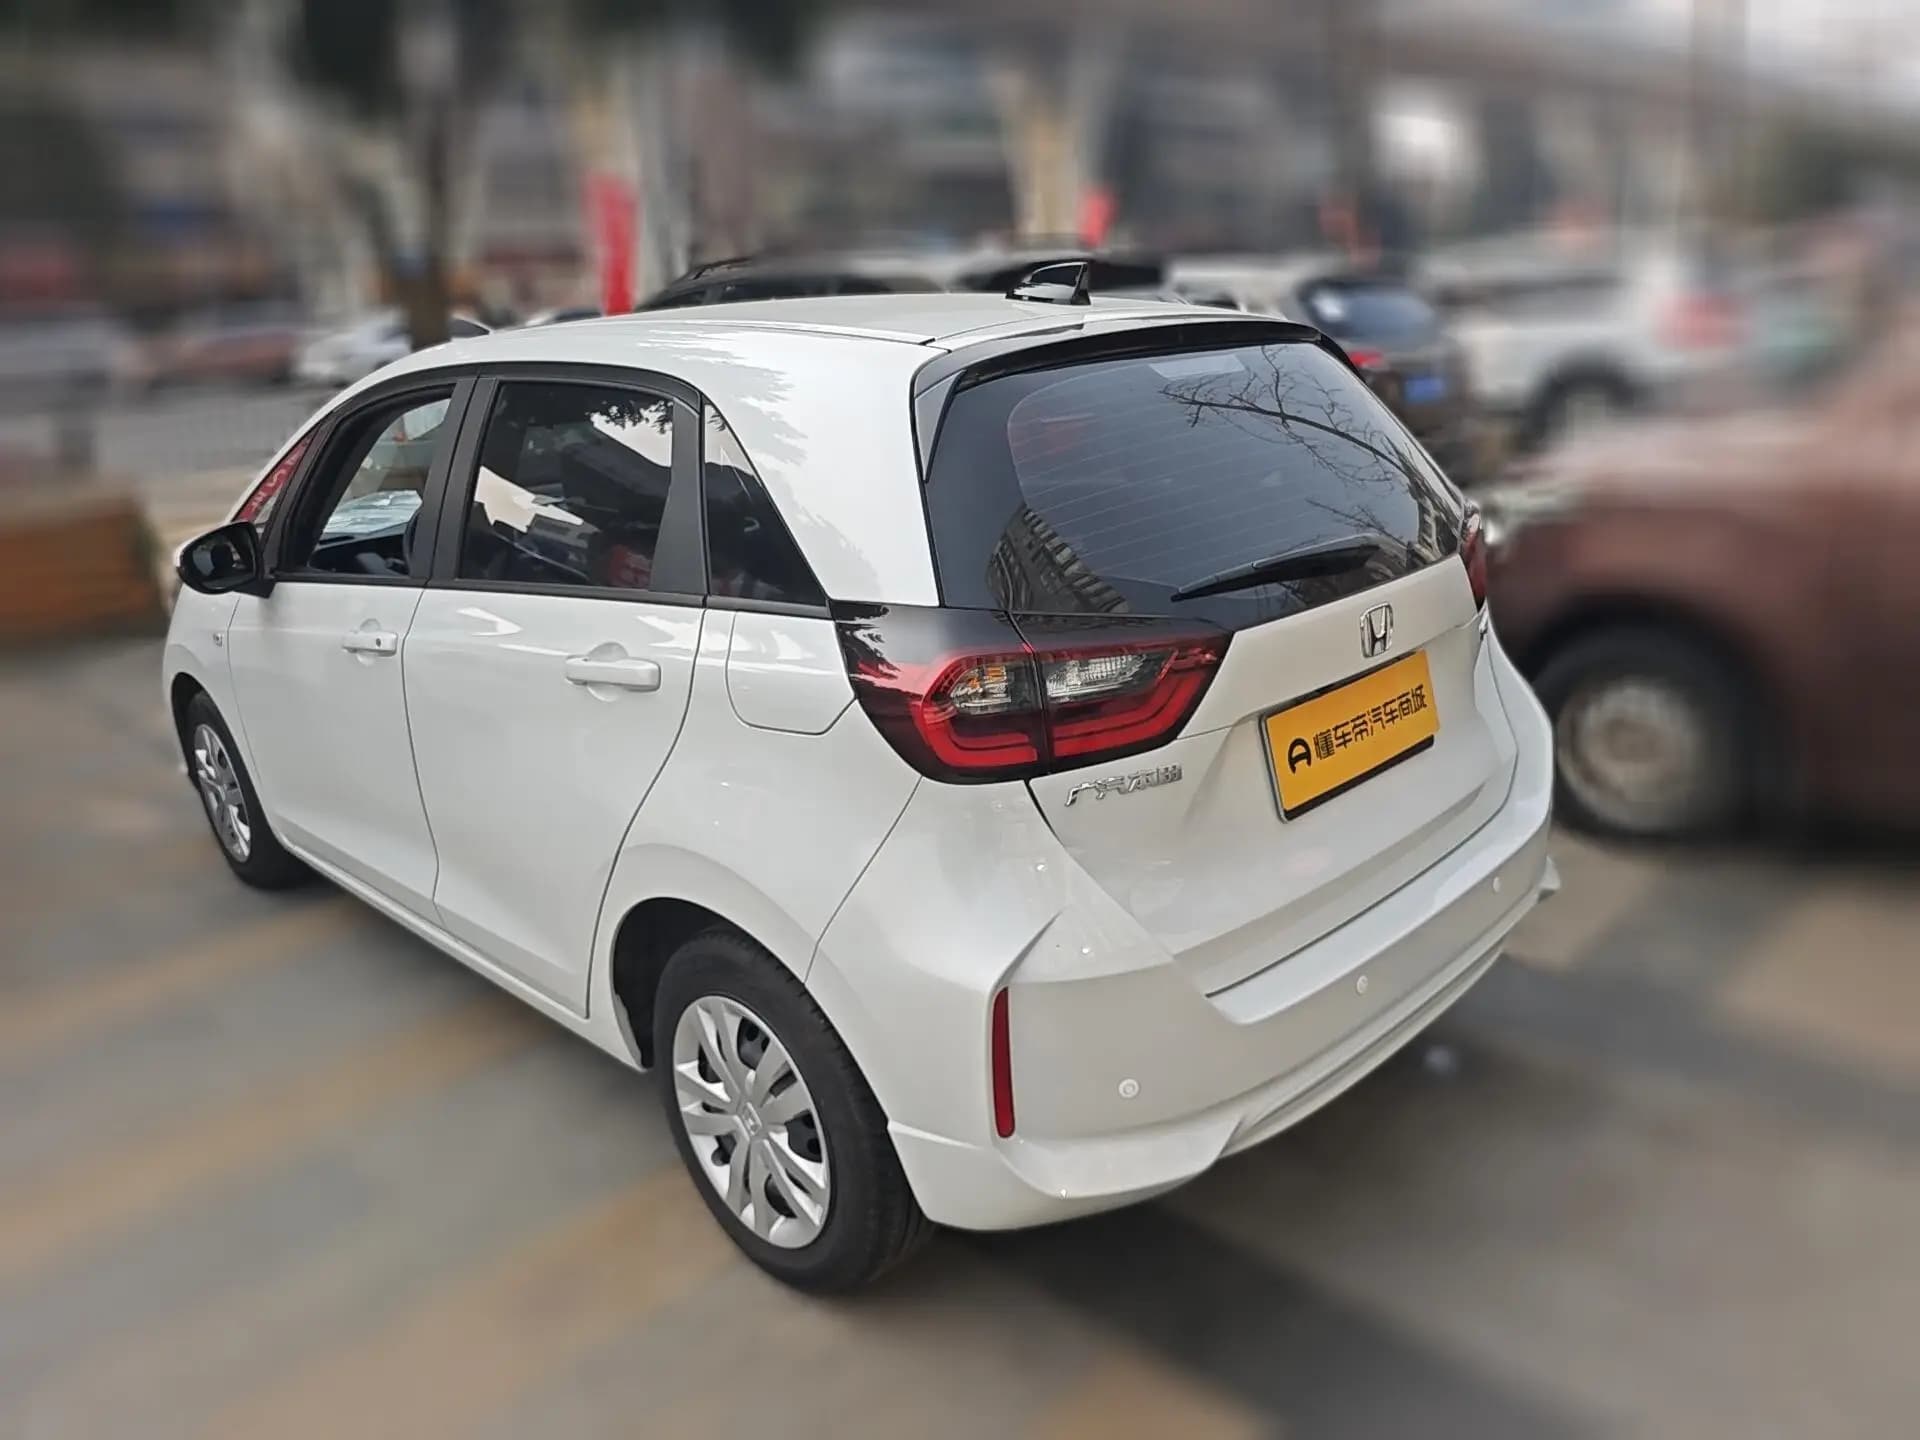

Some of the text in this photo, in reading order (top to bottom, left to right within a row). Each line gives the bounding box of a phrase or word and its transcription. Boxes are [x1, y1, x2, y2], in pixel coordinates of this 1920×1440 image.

[1313, 684, 1427, 760] 懂车帝汽车商城
